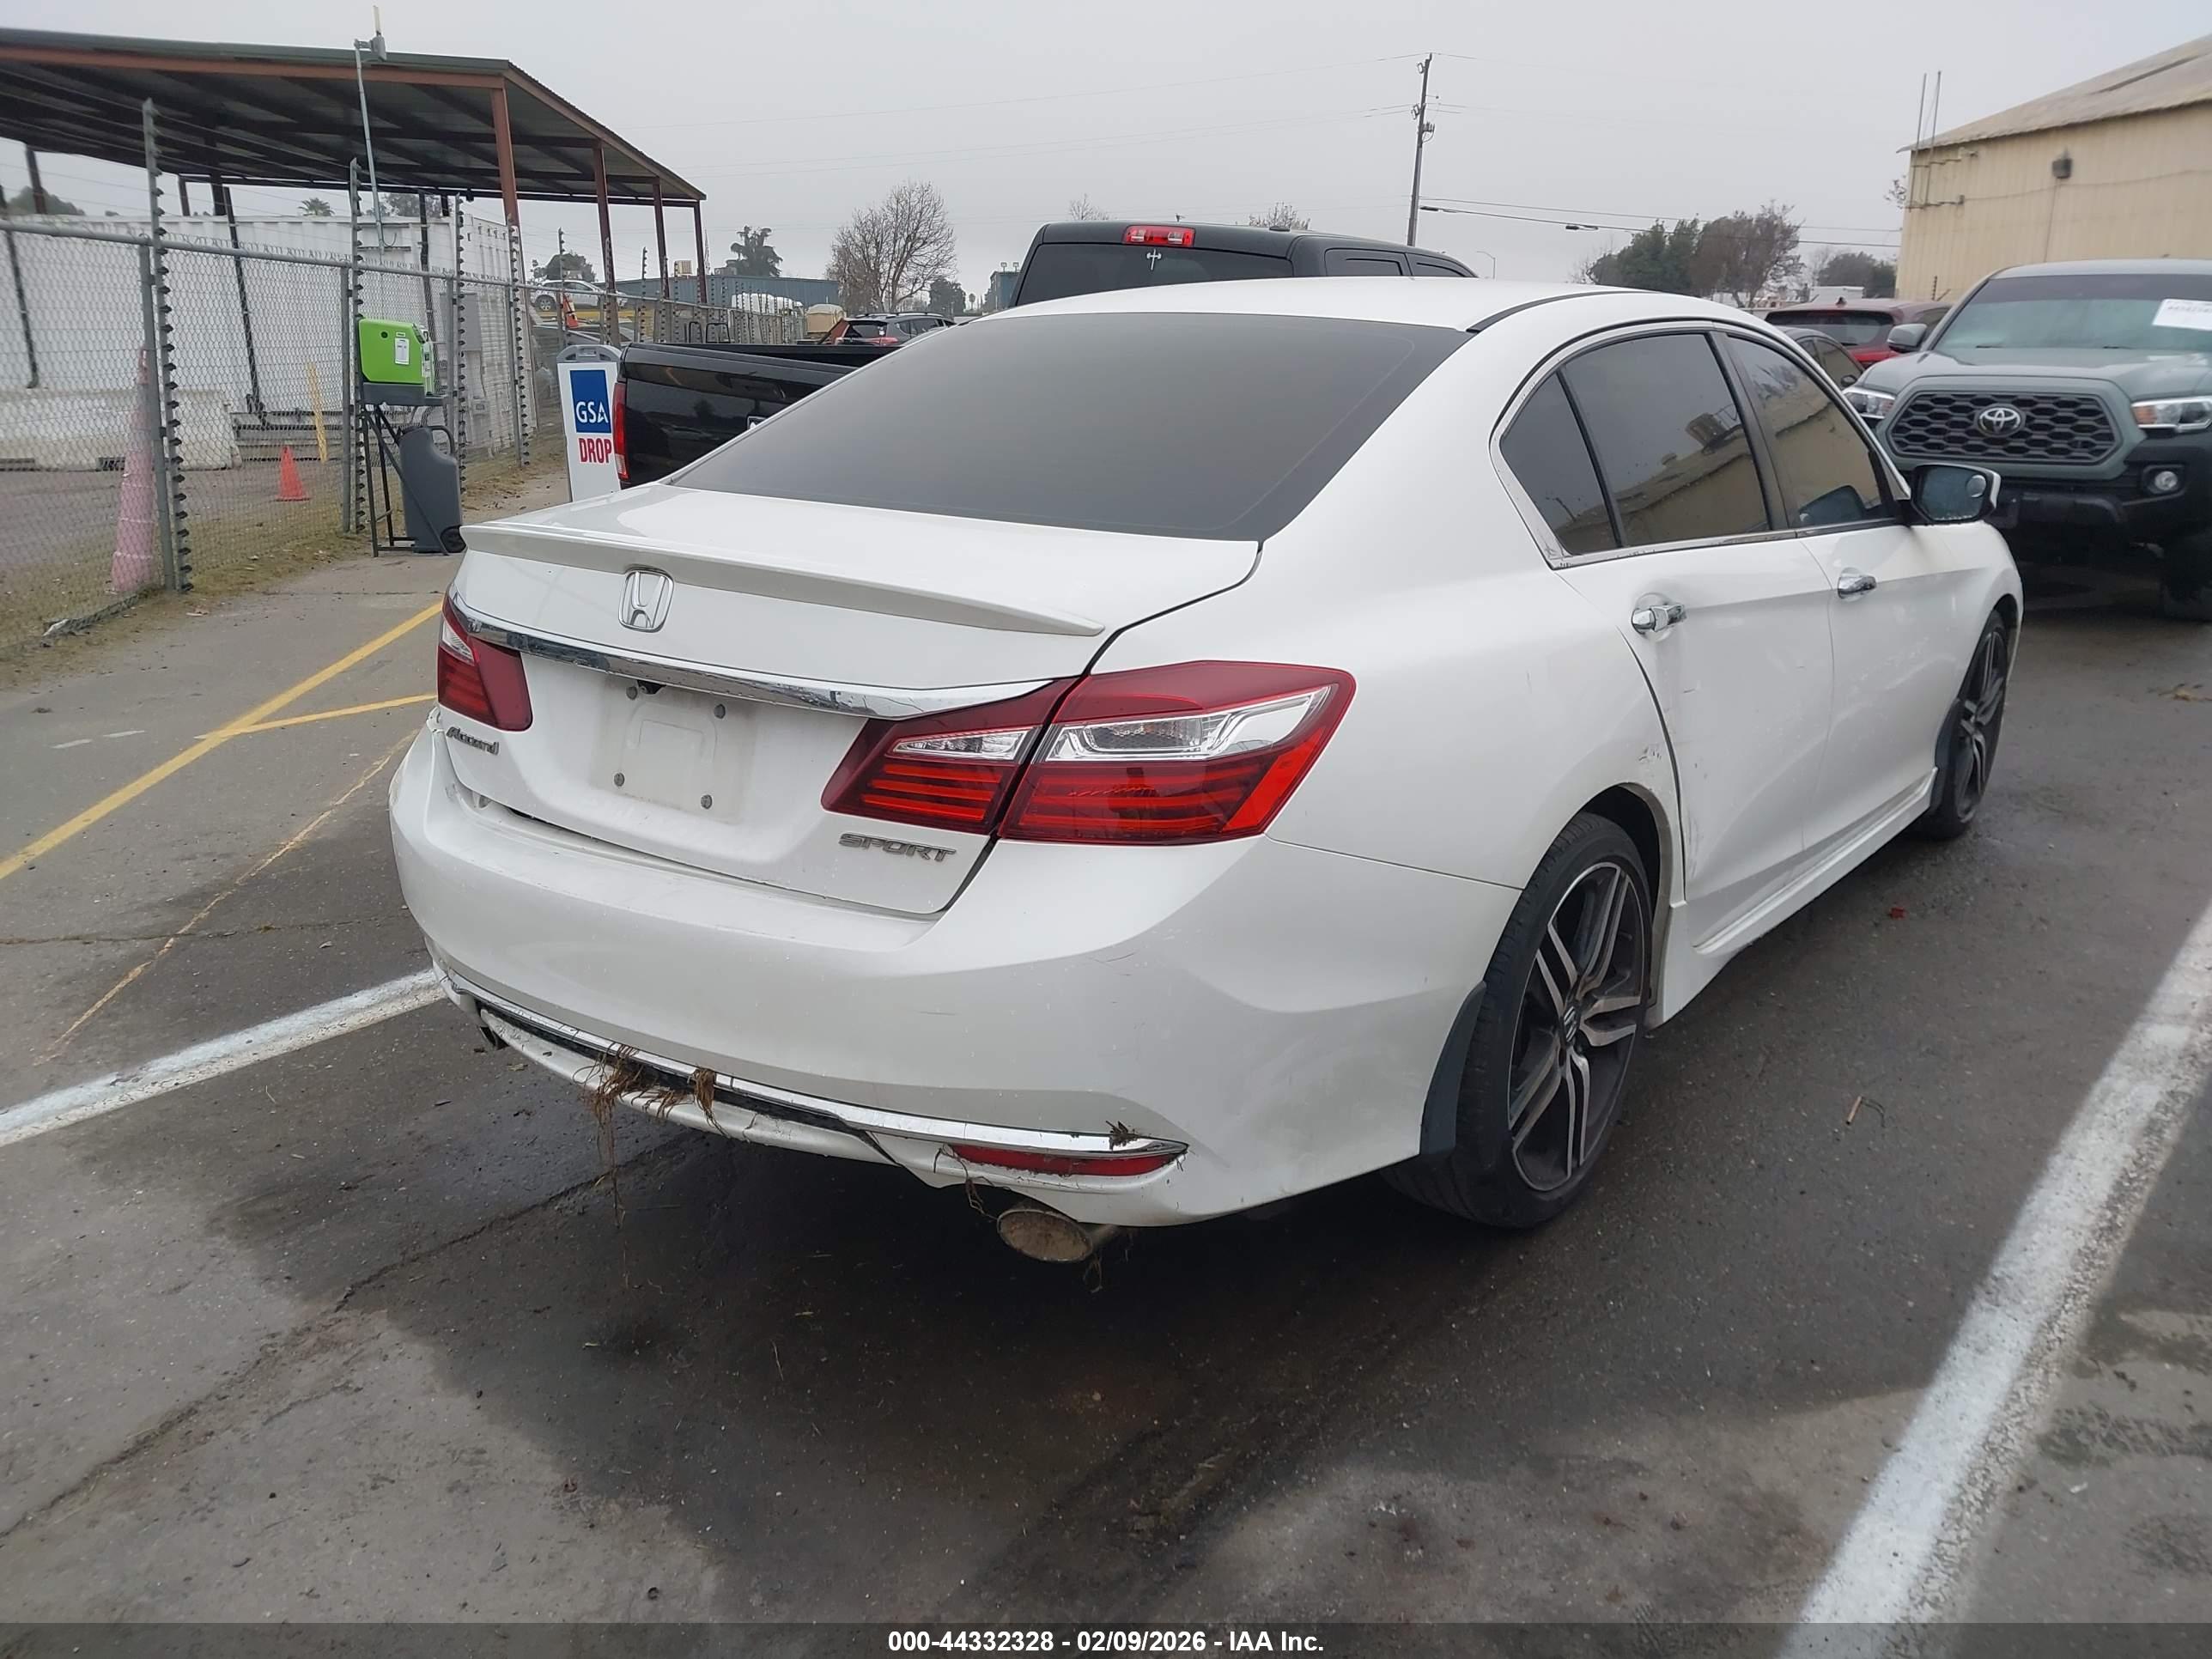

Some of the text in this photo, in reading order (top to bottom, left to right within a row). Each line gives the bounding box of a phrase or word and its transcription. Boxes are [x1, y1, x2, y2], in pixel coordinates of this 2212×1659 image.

[575, 401, 609, 423] GSA
[579, 438, 612, 464] DROP
[447, 726, 500, 756] Accord
[838, 833, 957, 862] SPORT
